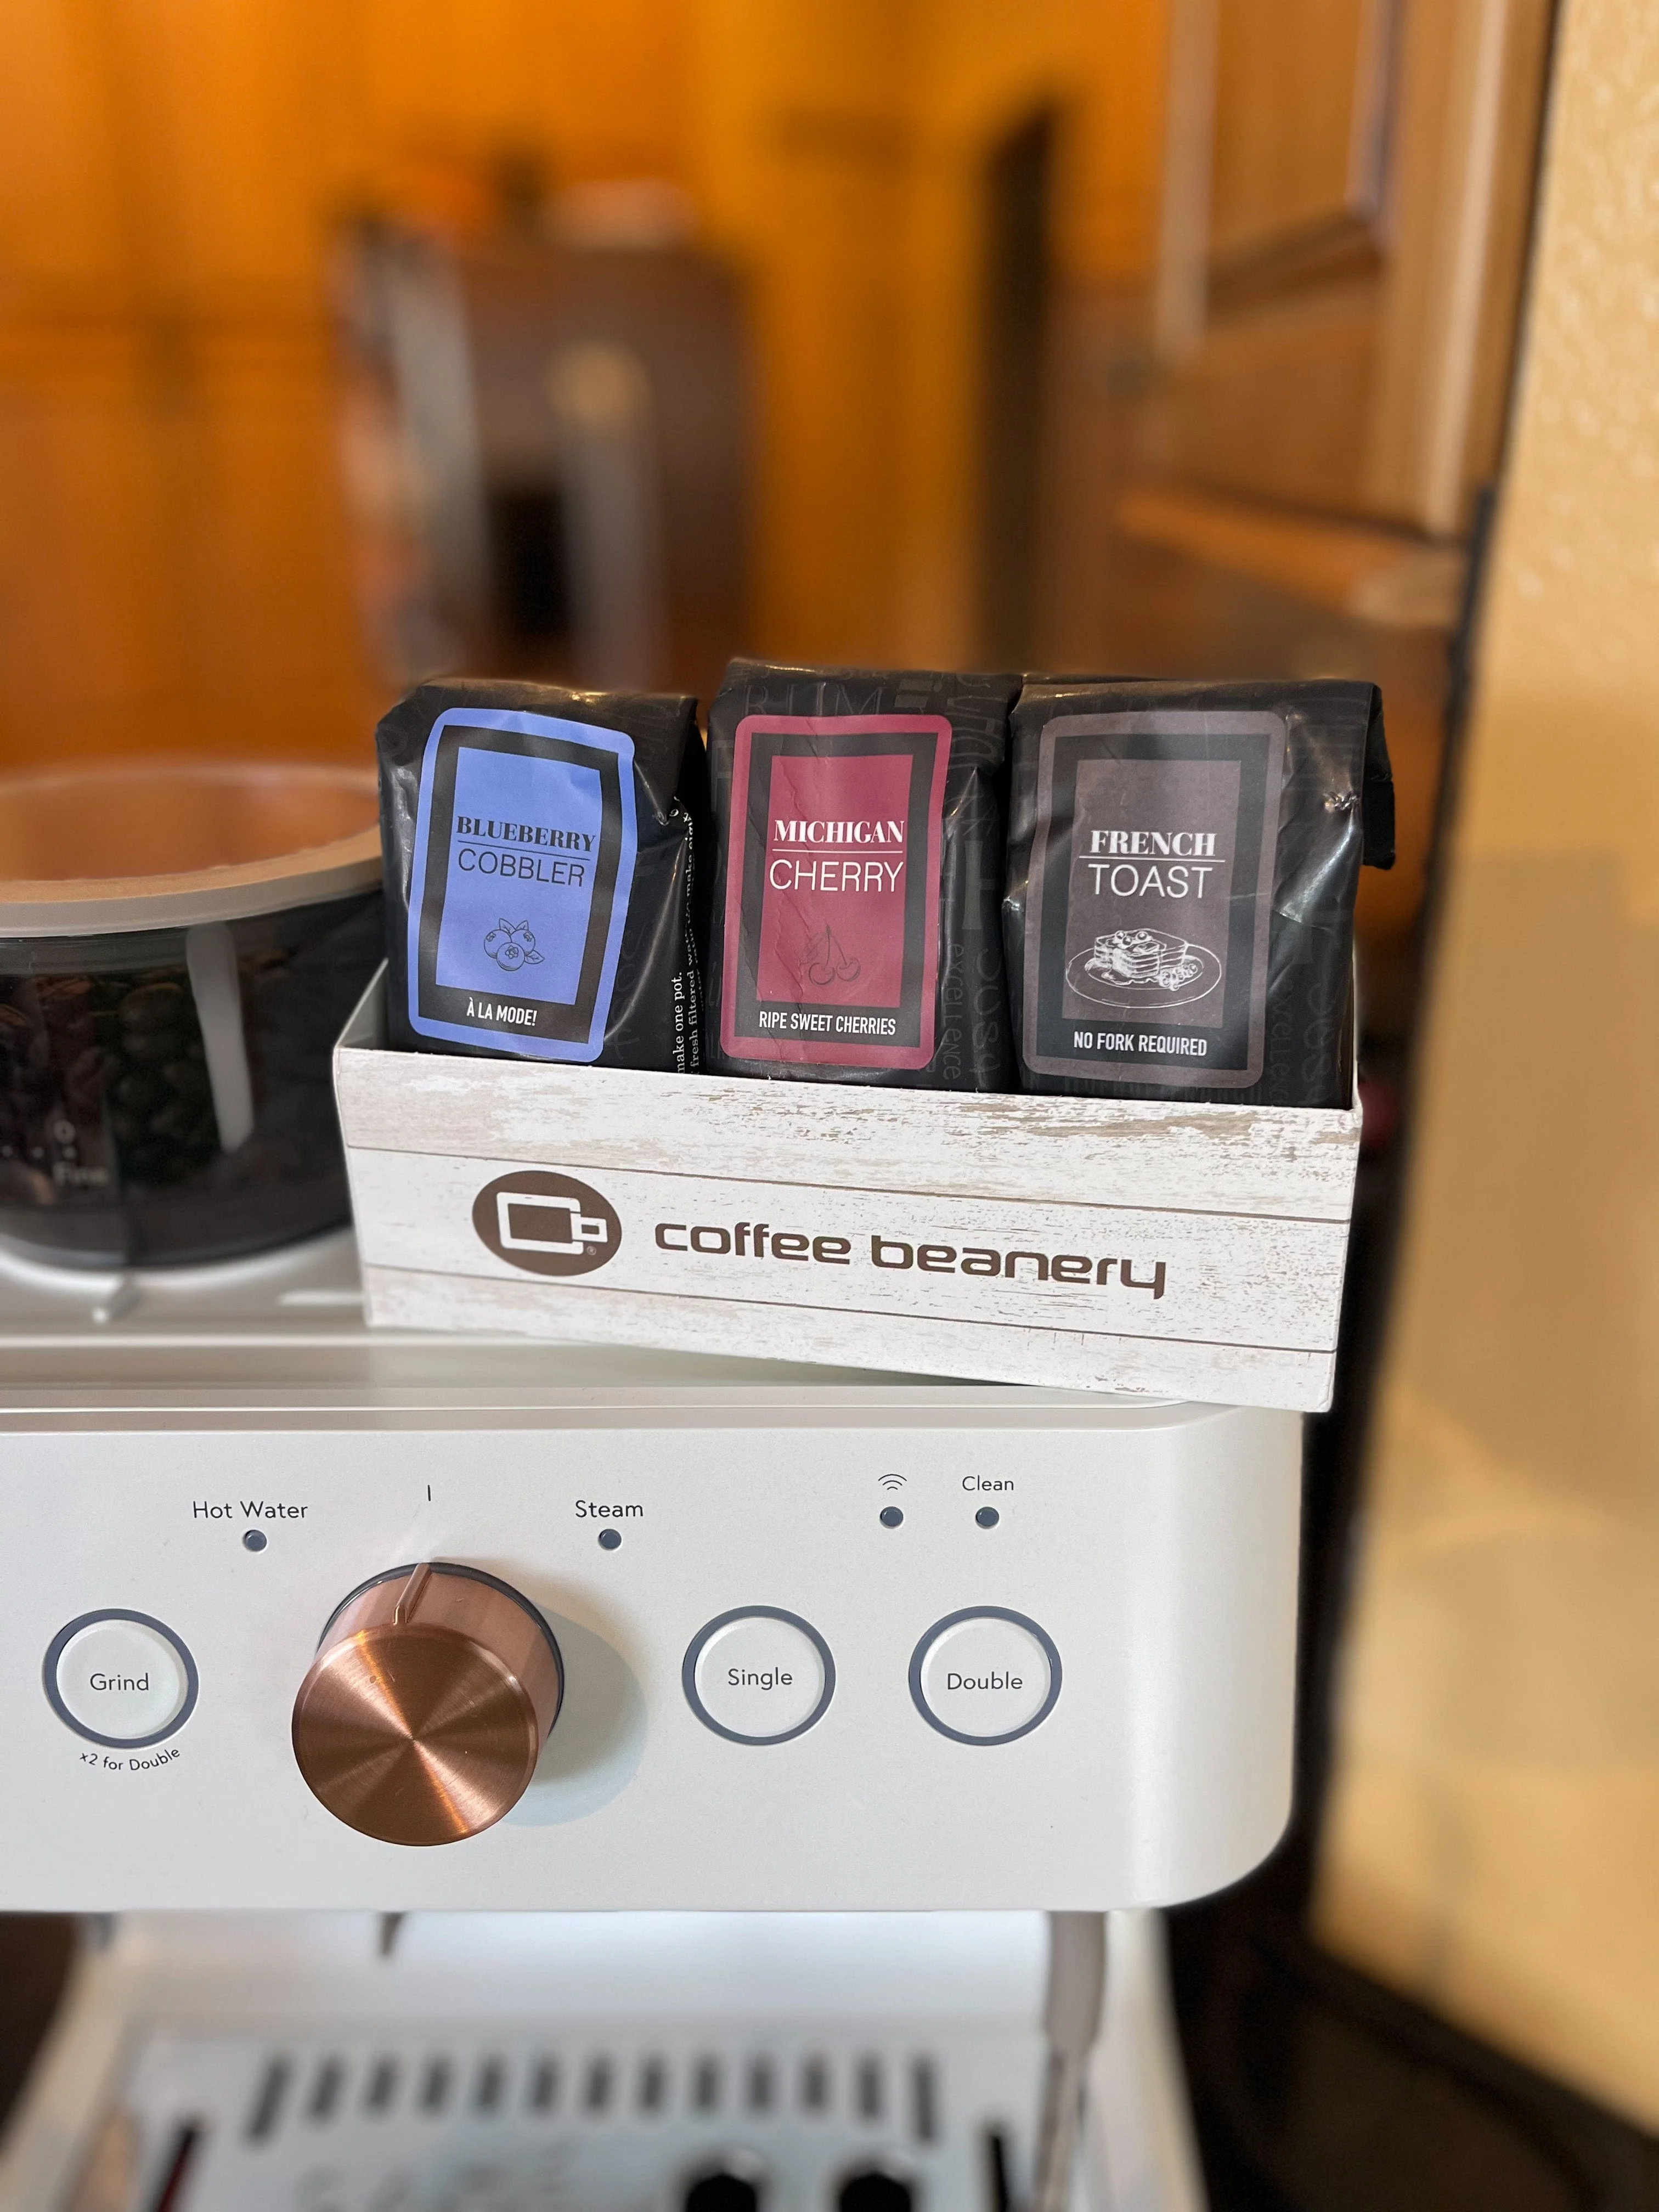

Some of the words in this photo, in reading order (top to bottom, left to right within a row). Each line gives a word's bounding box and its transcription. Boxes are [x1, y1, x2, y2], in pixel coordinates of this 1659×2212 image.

[456, 816, 596, 852] BLUEBERRY
[774, 820, 904, 843] MICHIGAN
[1090, 830, 1217, 856] FRENCH
[458, 848, 585, 887] COBBLER
[770, 859, 904, 892] CHERRY
[1088, 864, 1213, 899] TOAST
[671, 972, 685, 1001] pot.
[687, 970, 697, 1024] filtered
[466, 997, 475, 1017] À
[478, 1002, 493, 1020] LA
[496, 1005, 537, 1025] MODE!
[674, 1005, 684, 1031] one
[759, 1011, 787, 1029] RIPE
[790, 1013, 833, 1031] SWEET
[836, 1015, 896, 1035] CHERRIES
[689, 1029, 699, 1067] fresh
[1074, 1031, 1093, 1049] NO
[1097, 1032, 1135, 1051] FORK
[1138, 1035, 1207, 1056] REQUIRED
[654, 1222, 851, 1265] coffee
[871, 1234, 1166, 1300] beanery
[962, 1475, 1014, 1491] Clean
[193, 1501, 233, 1519] Hot
[240, 1501, 308, 1519] Water
[575, 1499, 644, 1518] Steam
[90, 1672, 149, 1691] Grind
[728, 1667, 793, 1691] Single
[947, 1671, 1023, 1690] Double
[80, 1753, 98, 1765] x2
[103, 1756, 123, 1770] for
[129, 1749, 180, 1771] Double
